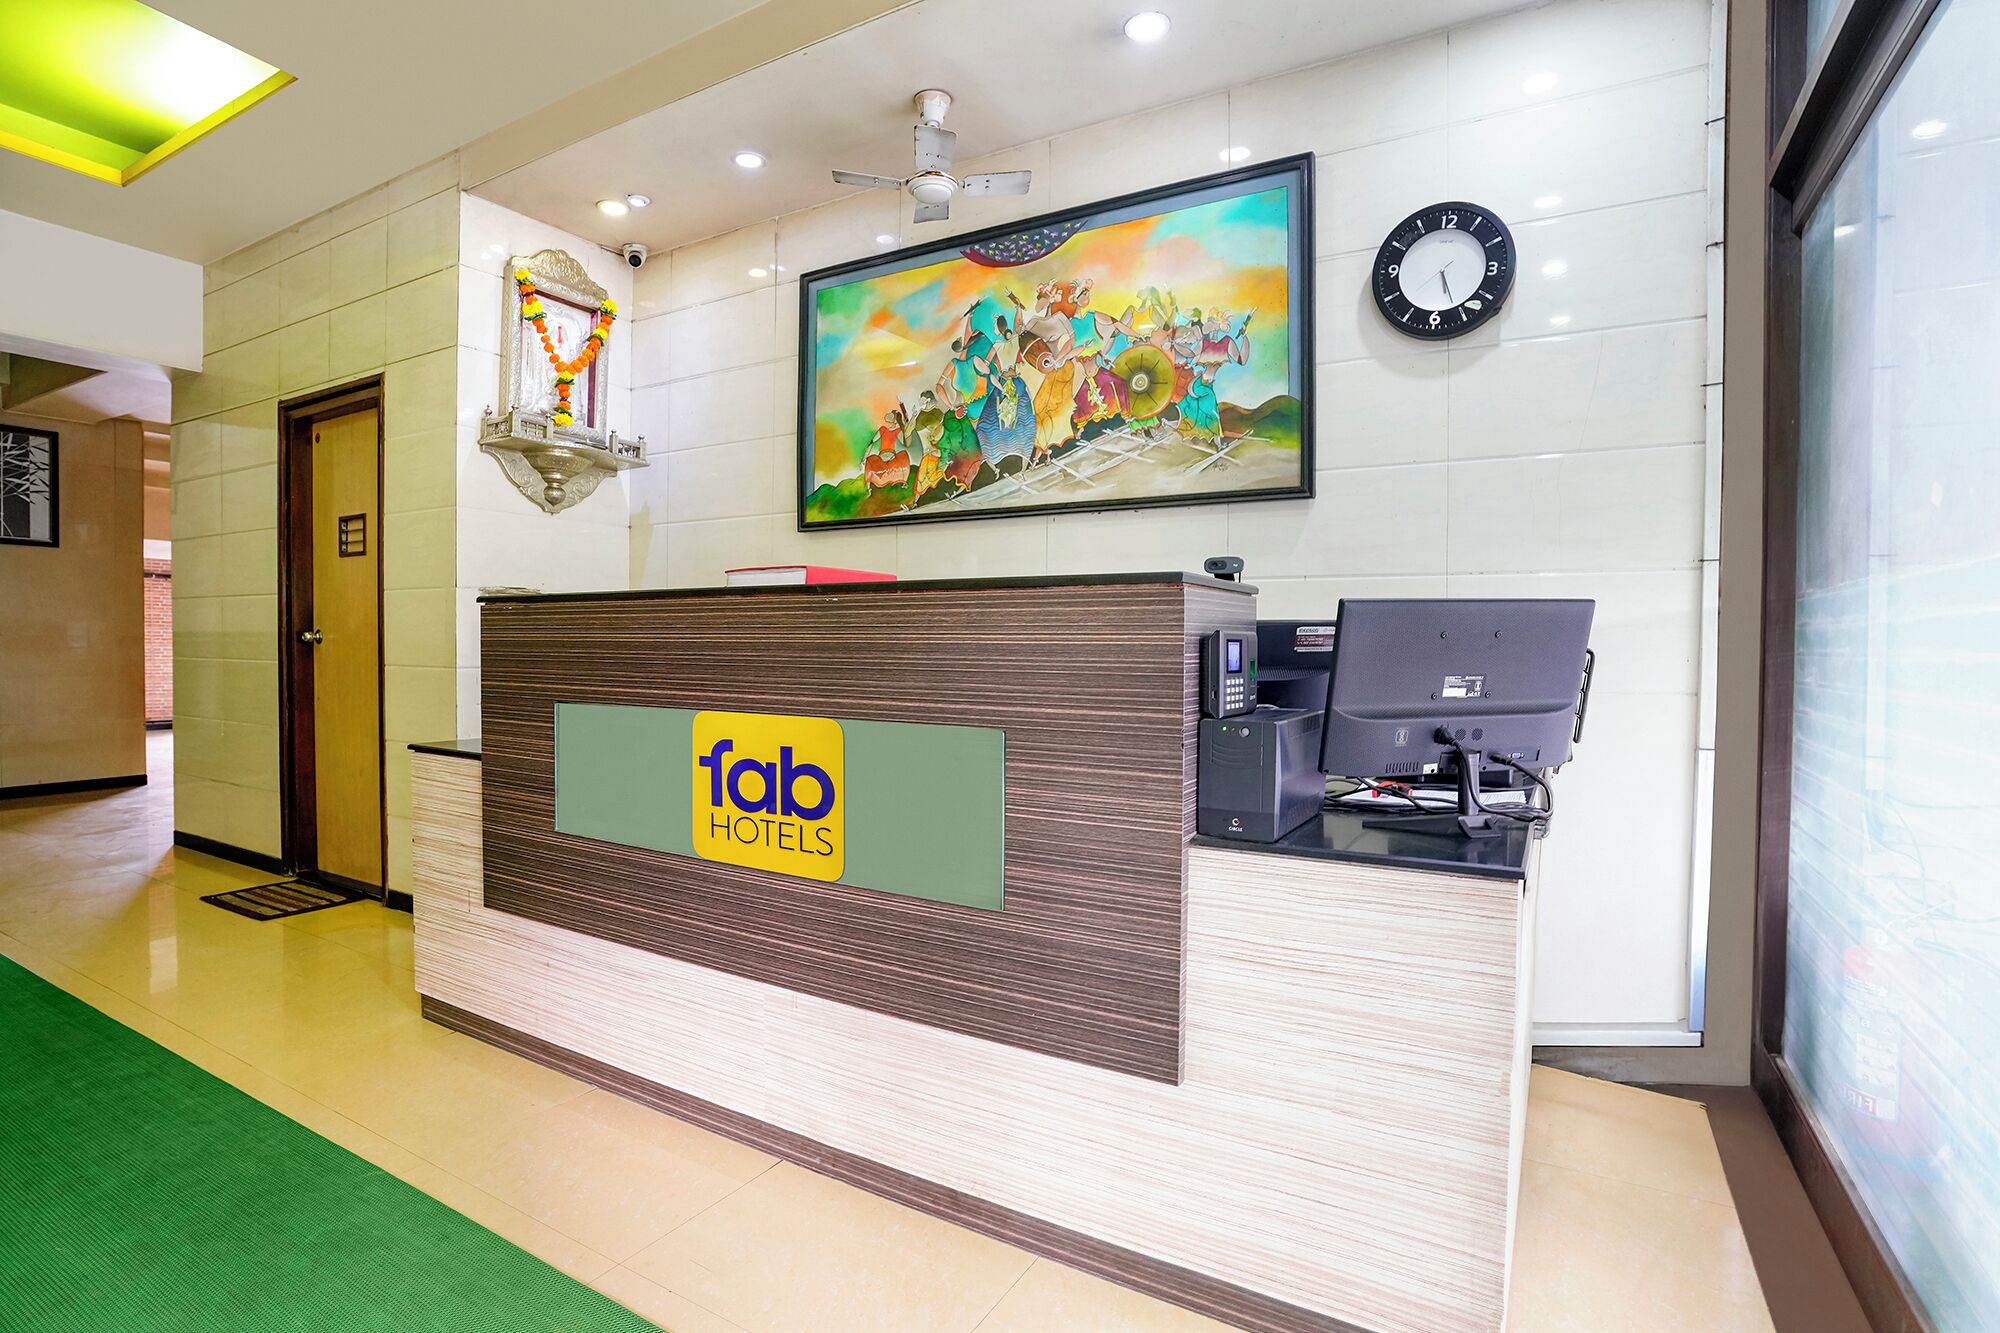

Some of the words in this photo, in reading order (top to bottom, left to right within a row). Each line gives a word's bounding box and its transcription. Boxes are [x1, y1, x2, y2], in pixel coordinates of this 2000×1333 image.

[1441, 215, 1457, 229] 12
[1388, 264, 1399, 279] 9
[1486, 261, 1498, 275] 3
[1429, 310, 1441, 325] 6
[699, 739, 835, 820] fab
[711, 812, 834, 857] HOTELS
